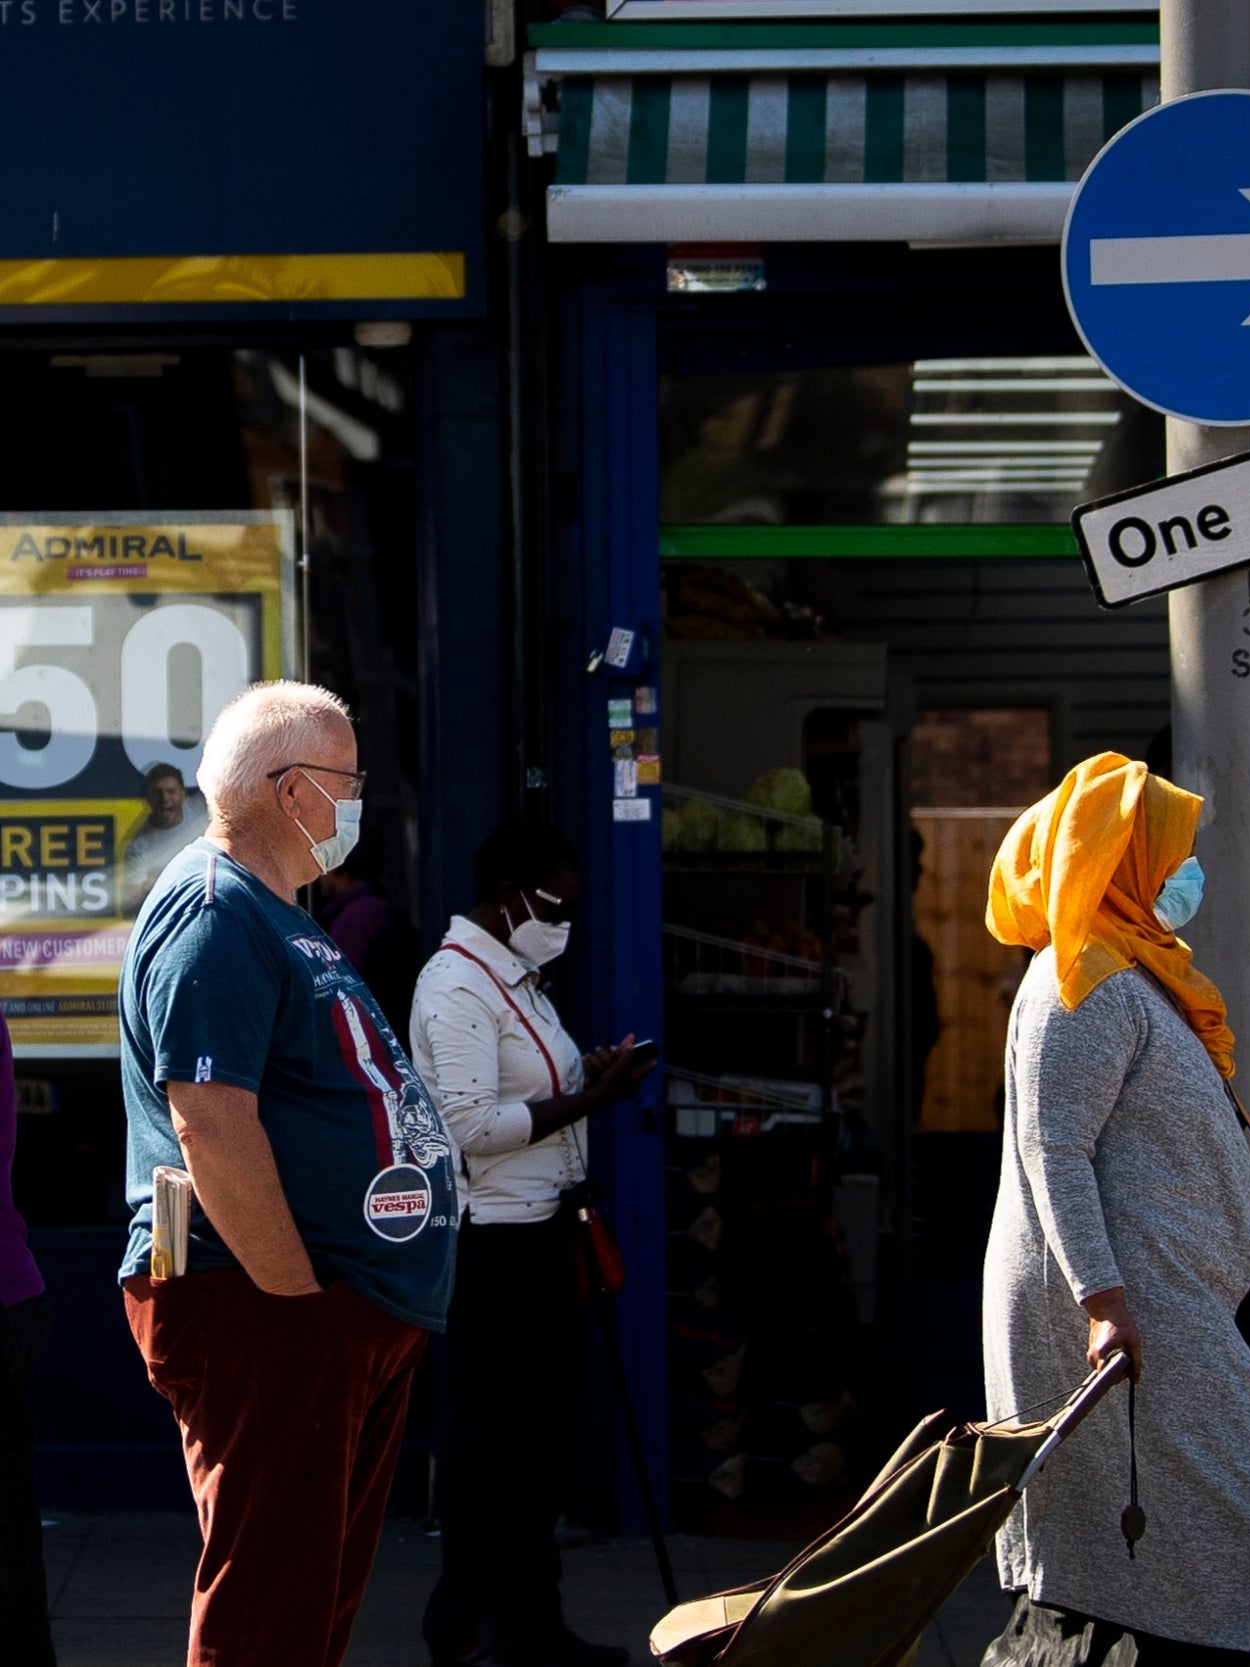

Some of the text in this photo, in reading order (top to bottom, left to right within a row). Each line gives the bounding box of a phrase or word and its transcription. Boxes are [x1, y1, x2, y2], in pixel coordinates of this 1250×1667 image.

[58, 0, 298, 24] EXPERIENCE
[10, 532, 204, 562] ADMIRAL
[1107, 503, 1233, 568] One
[0, 603, 248, 789] 50
[0, 824, 105, 868] REE
[0, 871, 109, 913] PINS
[2, 940, 39, 959] NEW
[27, 1001, 57, 1012] ONLINE
[371, 1199, 426, 1214] vespa
